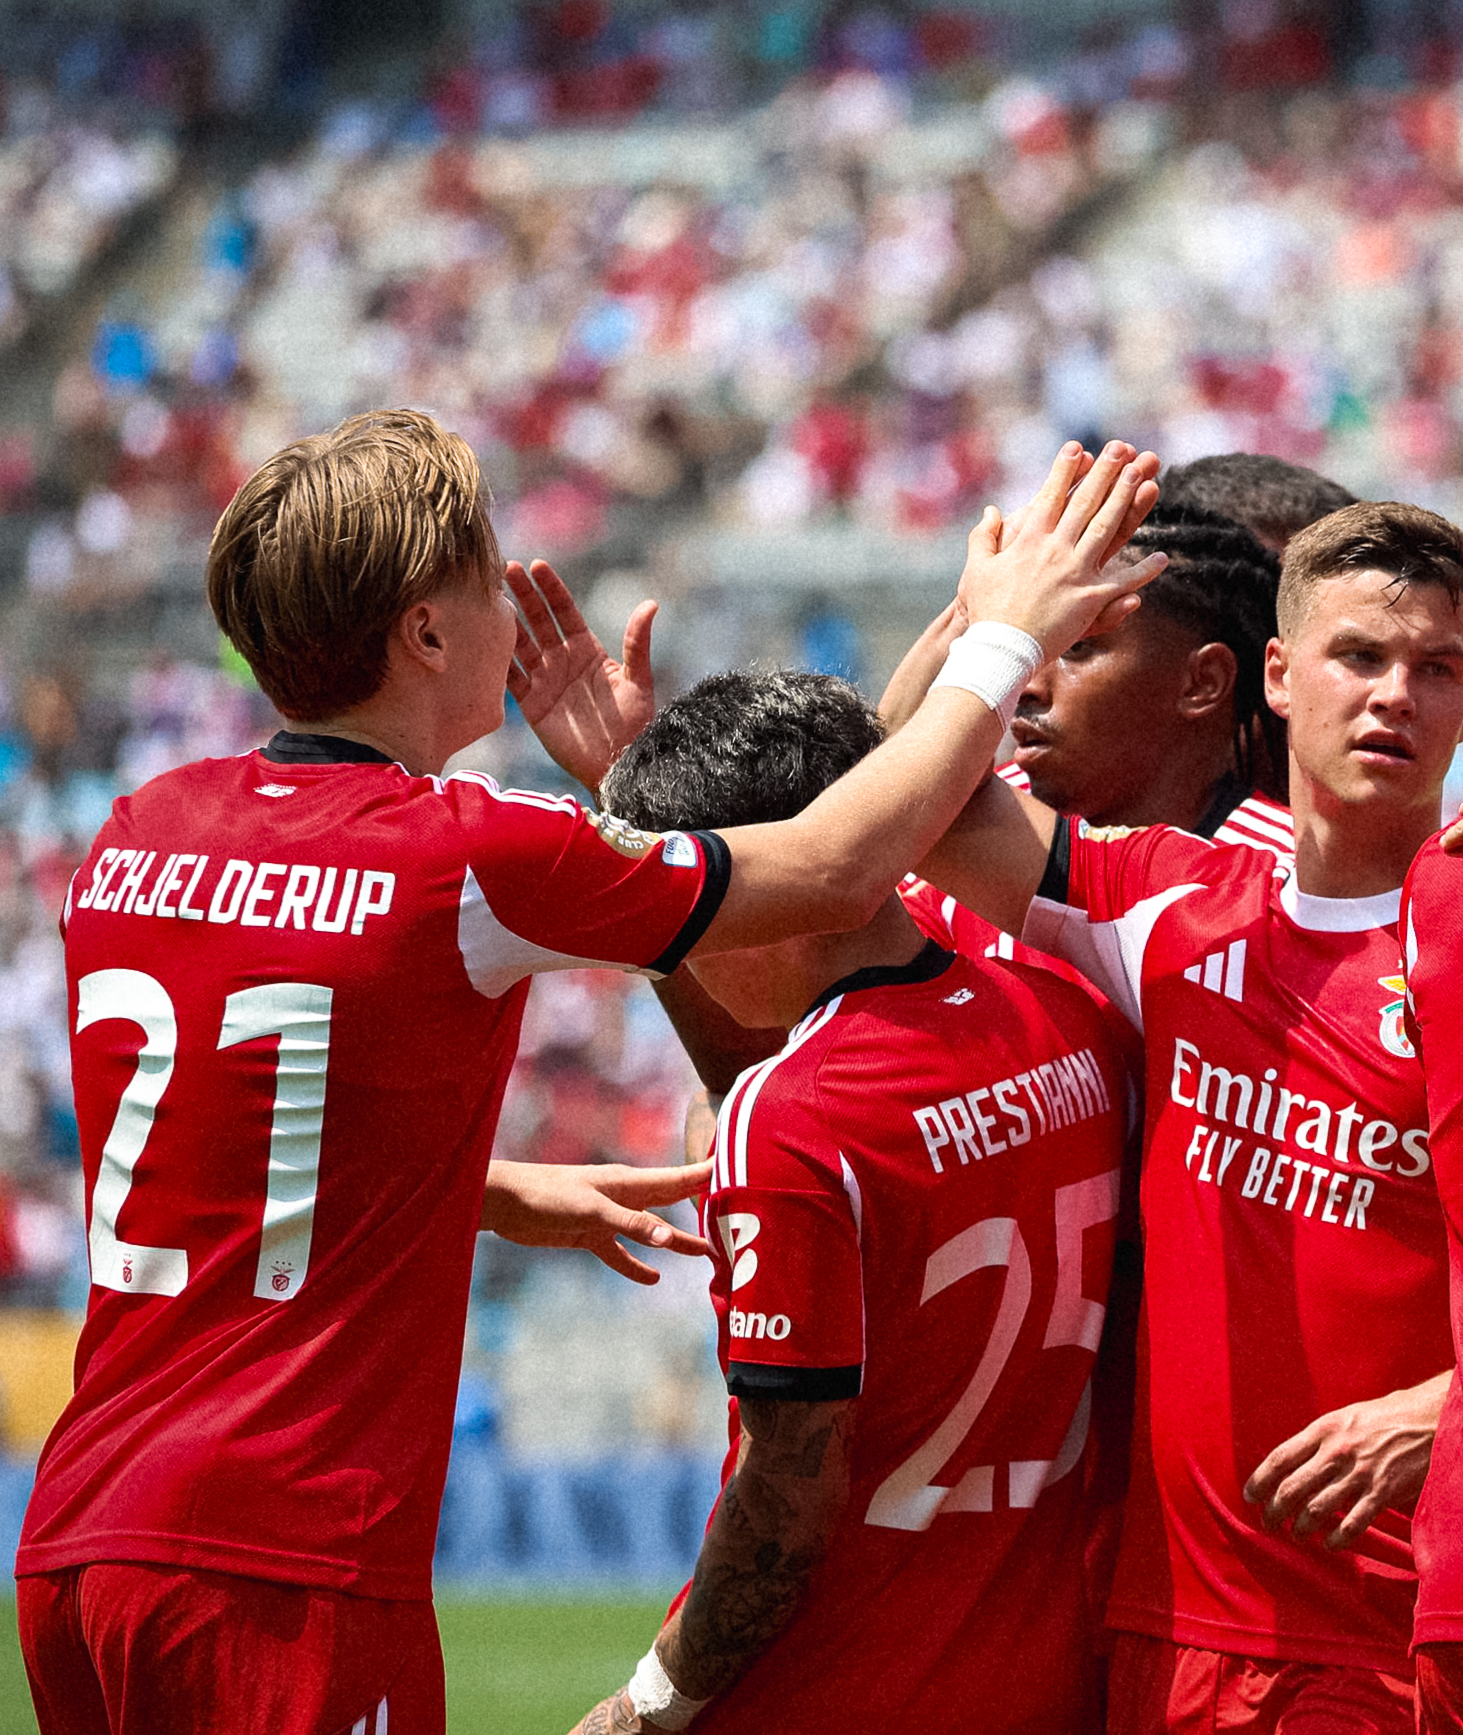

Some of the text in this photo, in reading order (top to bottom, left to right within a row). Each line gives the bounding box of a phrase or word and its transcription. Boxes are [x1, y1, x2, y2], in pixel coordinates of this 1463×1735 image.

[77, 848, 396, 936] SCHJELDERUP
[75, 968, 334, 1301] 21
[912, 1047, 1111, 1174] PRESTIANNI
[1171, 1037, 1431, 1178] Emirates
[1185, 1124, 1376, 1230] FLY BETTER
[863, 1167, 1122, 1532] 25
